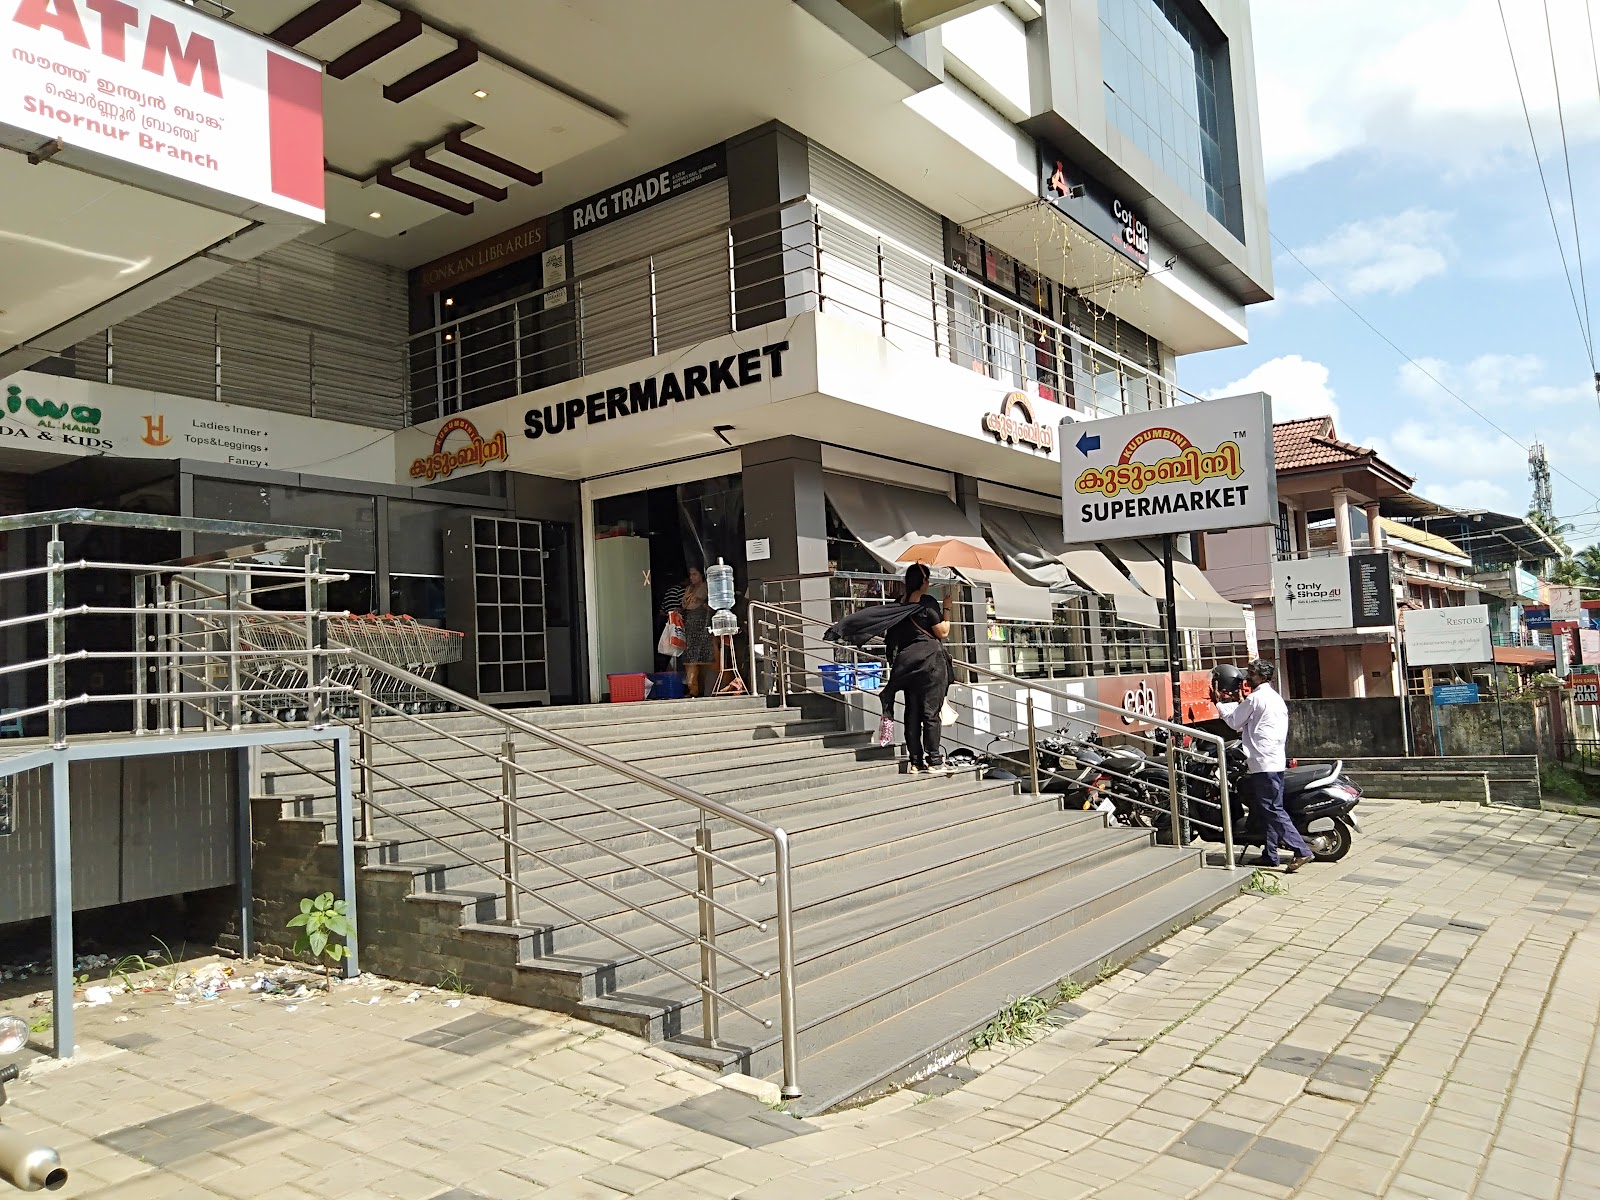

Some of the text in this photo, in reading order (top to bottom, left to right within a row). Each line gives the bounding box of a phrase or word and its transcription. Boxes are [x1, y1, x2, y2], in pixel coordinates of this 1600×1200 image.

[12, 0, 224, 99] ATM
[24, 95, 219, 171] Shornur Branch
[573, 198, 608, 230] RAG
[611, 171, 671, 214] TRADE
[1113, 199, 1148, 239] Cotton
[478, 228, 541, 265] LIBRARIES
[0, 384, 101, 425] iwa
[523, 340, 789, 440] SUPERMARKET
[37, 431, 55, 442] &
[63, 433, 113, 449] KIDS
[184, 433, 262, 453] Tops&Leggings
[192, 419, 261, 437] Ladies Inner
[1123, 429, 1187, 458] KUDUMBINI
[1233, 431, 1247, 439] TM
[228, 455, 262, 468] Fancy
[410, 431, 507, 480] കുടുംബിനി
[1077, 443, 1240, 496] കുടുംബിനി
[1081, 486, 1249, 523] SUPERMARKET
[1297, 583, 1322, 591] Only
[1329, 588, 1341, 597] 4U
